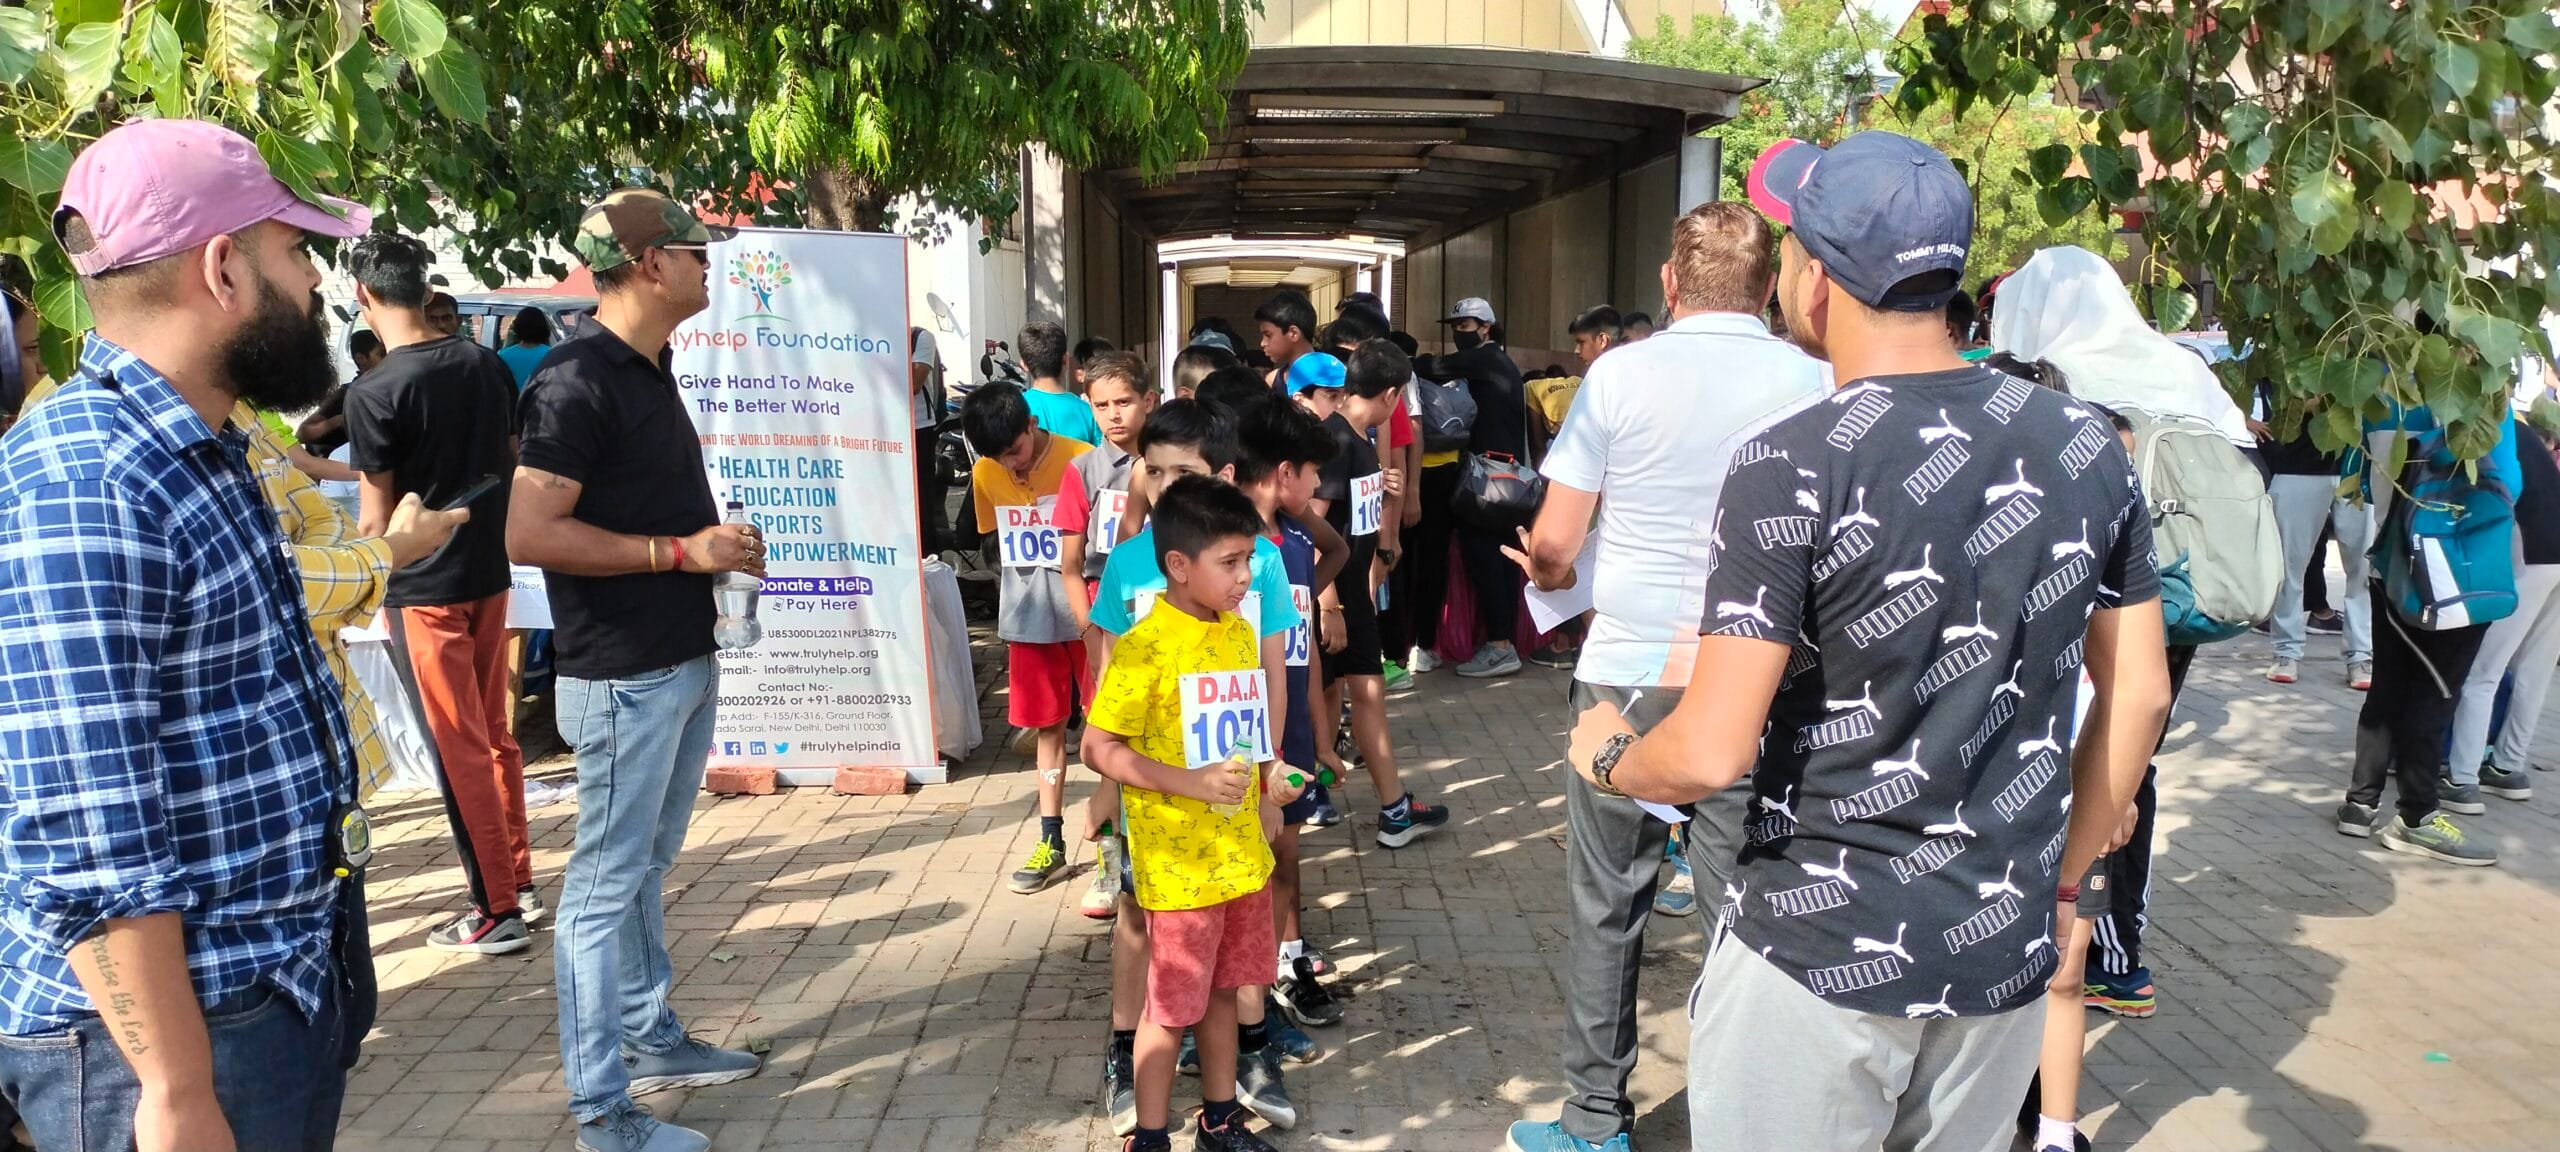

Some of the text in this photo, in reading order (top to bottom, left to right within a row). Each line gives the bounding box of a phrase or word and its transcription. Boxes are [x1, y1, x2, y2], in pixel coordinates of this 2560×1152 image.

[1895, 245, 1935, 263] TOMMY
[667, 327, 890, 353] lyhelp Foundation
[679, 374, 855, 393] Give Hand To Make
[697, 398, 840, 416] The Better World
[1826, 391, 1894, 452] PUMA
[737, 433, 771, 446] WORLD
[773, 433, 818, 447] DREAMING
[821, 434, 832, 446] OF
[841, 436, 870, 450] BRIGHT
[872, 438, 904, 454] FUTURE
[2058, 419, 2110, 480] PUMA
[719, 456, 844, 479] HEALTH CARE
[1903, 437, 1971, 506] PUMA
[732, 485, 837, 507] EDUCATION
[751, 512, 822, 535] SPORTS
[1964, 494, 2041, 568] PUMA
[763, 540, 897, 566] NPOWERMENT
[1004, 529, 1063, 561] 106
[759, 578, 870, 594] Donate & Help
[2020, 553, 2089, 623] PUMA
[787, 598, 858, 613] Pay Here
[1844, 580, 1939, 649] PUMA
[717, 648, 878, 660] ebsite:- www.trulyhelp.org
[764, 664, 871, 676] info@trulyhelp.org
[1913, 636, 1992, 706] PUMA
[716, 694, 912, 706] 800202926 or +91-8800202933
[758, 682, 833, 692] Contact No:-
[1198, 674, 1260, 705] D.A.A
[716, 724, 736, 733] ado
[769, 724, 792, 732] New
[825, 723, 850, 731] Delhi
[853, 723, 887, 731] 110030
[826, 711, 865, 720] Ground
[1960, 693, 2014, 769] PUMA
[800, 741, 901, 753] #trulyhelpindia
[1191, 708, 1268, 761] 1071
[1794, 709, 1874, 754] PUMA
[1830, 772, 1919, 824] PUMA
[1992, 750, 2057, 823] PUMA
[1889, 834, 1966, 885] PUMA
[1765, 879, 1850, 917] PUMA
[1943, 894, 2021, 955] PUMA
[1808, 955, 1902, 996] PUMA
[1986, 944, 2047, 1009] PUMA
